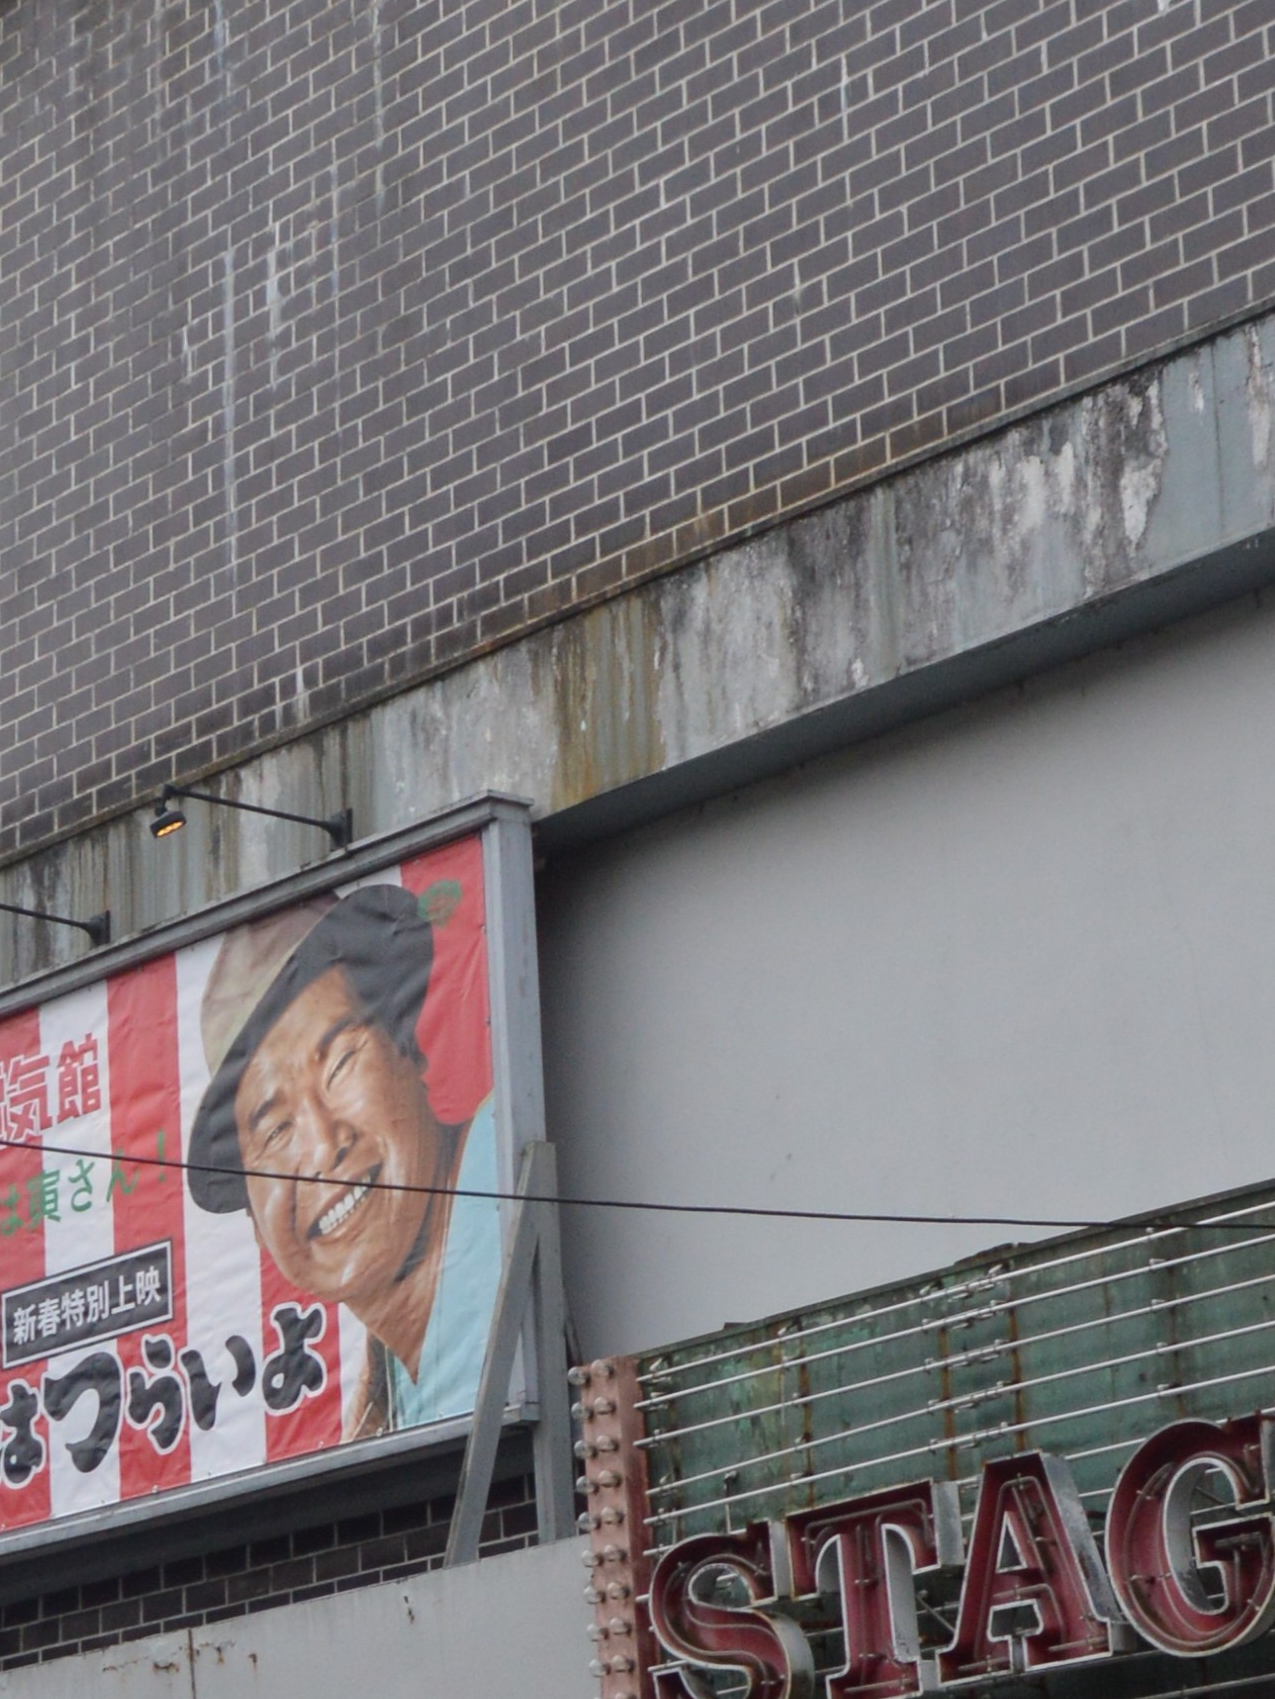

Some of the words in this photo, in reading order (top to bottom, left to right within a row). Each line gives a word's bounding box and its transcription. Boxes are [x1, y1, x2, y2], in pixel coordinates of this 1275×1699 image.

[11, 1265, 163, 1347] 新春特別上映
